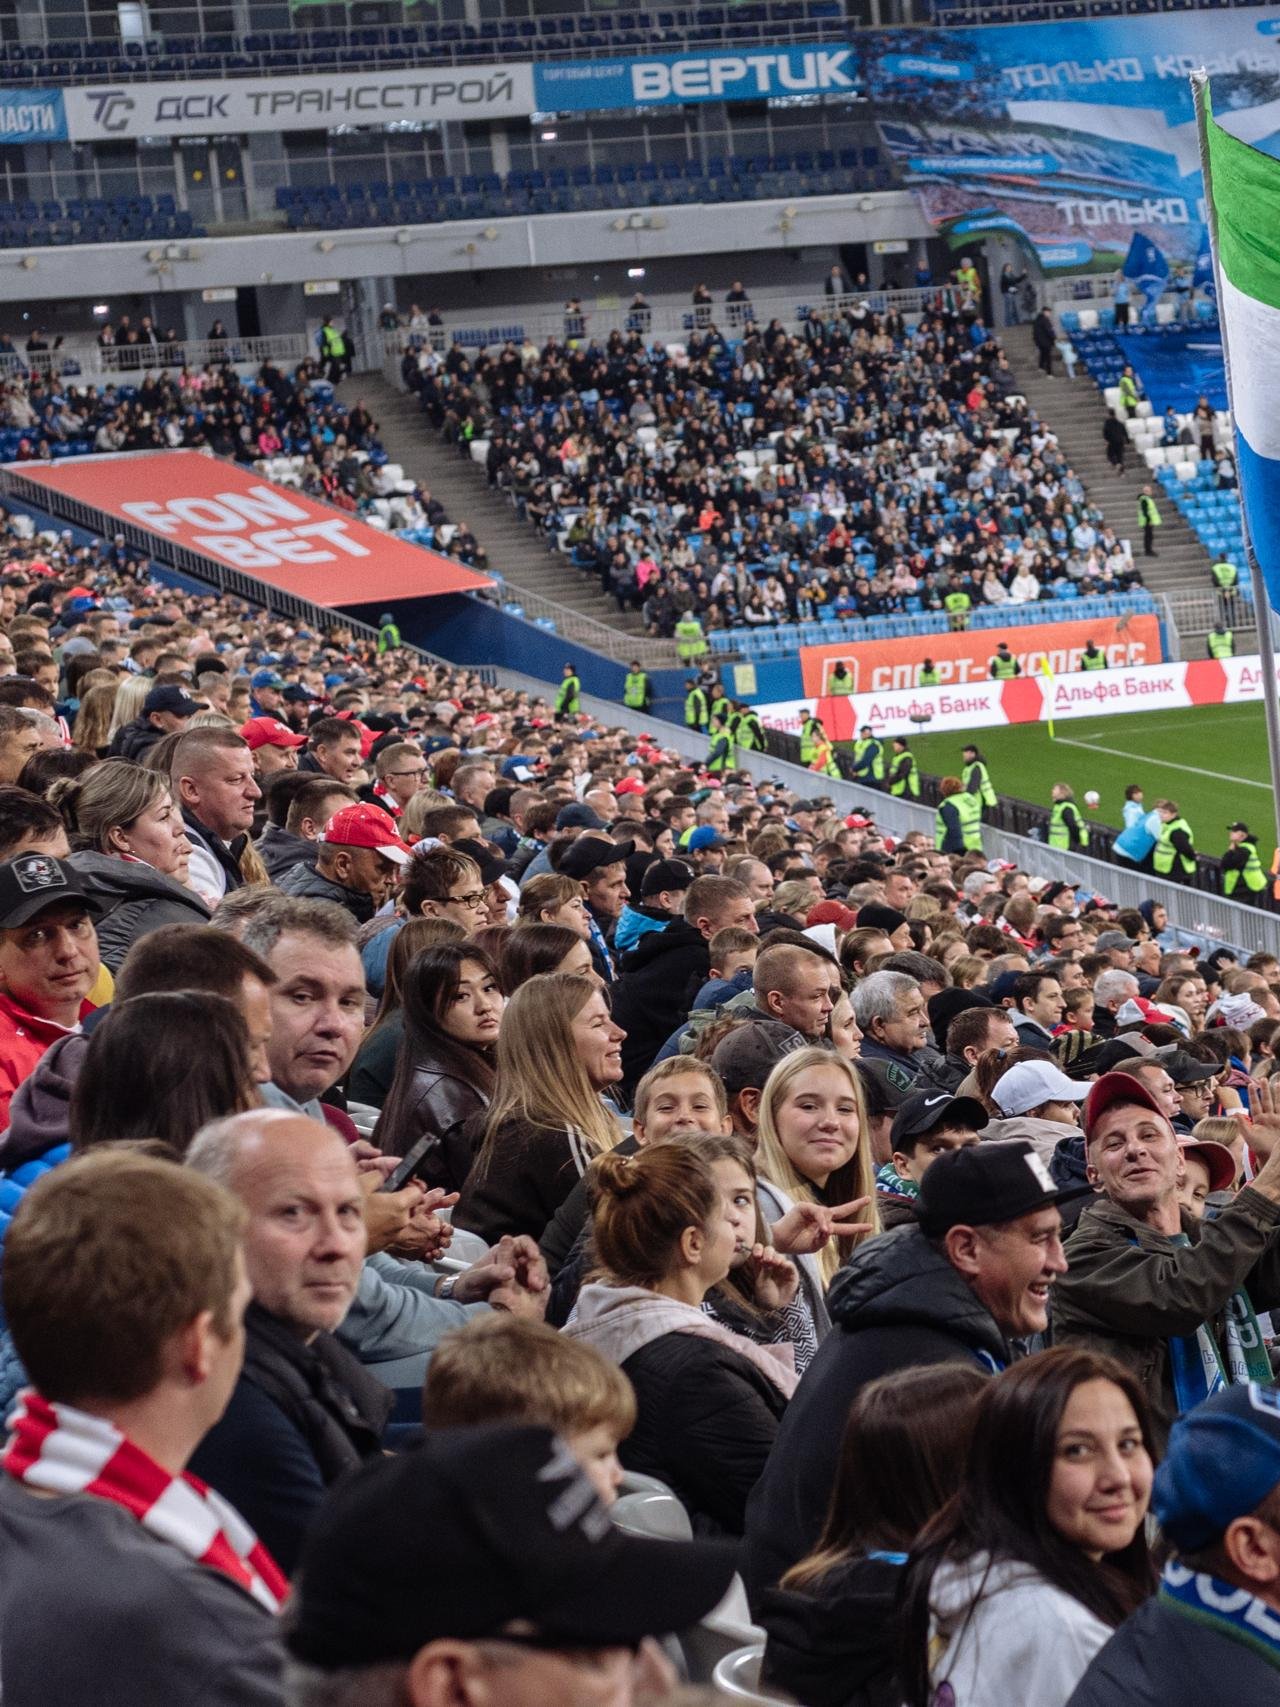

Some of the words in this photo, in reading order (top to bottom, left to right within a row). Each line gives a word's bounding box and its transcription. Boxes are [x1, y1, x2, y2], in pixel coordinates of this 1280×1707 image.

[1002, 58, 1144, 90] ТОЛЬКО
[155, 94, 230, 122] ДСК
[246, 72, 514, 116] ТРАНССТРОЙ
[1056, 198, 1188, 225] ТОЛЬКО
[122, 486, 310, 533] FON
[192, 518, 370, 568] BET
[1055, 682, 1121, 703] Альфа
[1126, 676, 1175, 696] Банк
[868, 699, 935, 722] Альфа
[939, 695, 992, 714] Банк
